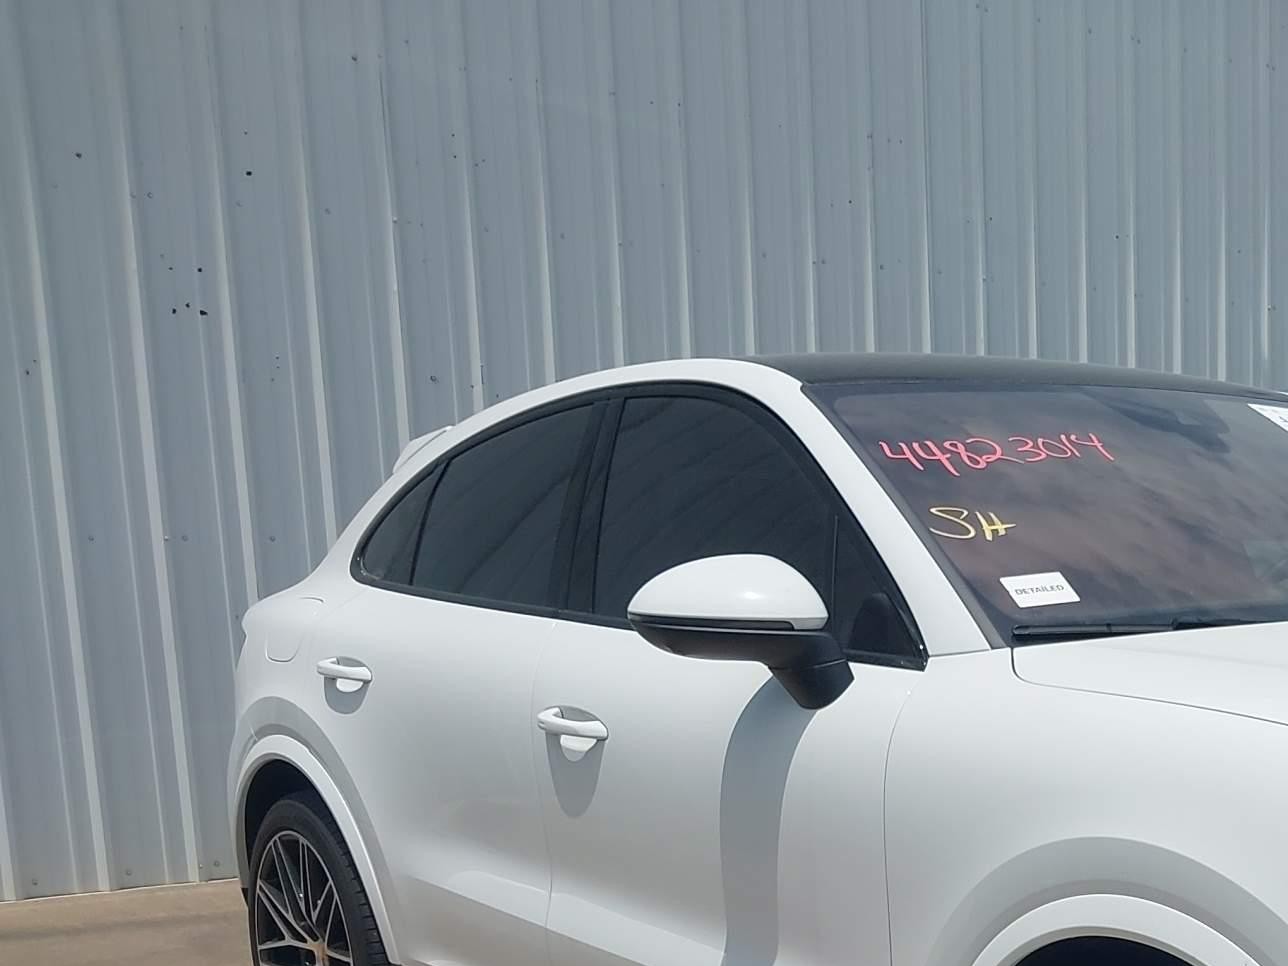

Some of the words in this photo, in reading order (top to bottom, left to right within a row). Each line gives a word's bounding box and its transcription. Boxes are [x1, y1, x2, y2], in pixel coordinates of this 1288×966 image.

[879, 432, 1114, 477] 44823014
[928, 506, 1017, 541] SH
[1014, 584, 1065, 596] DETAILED
